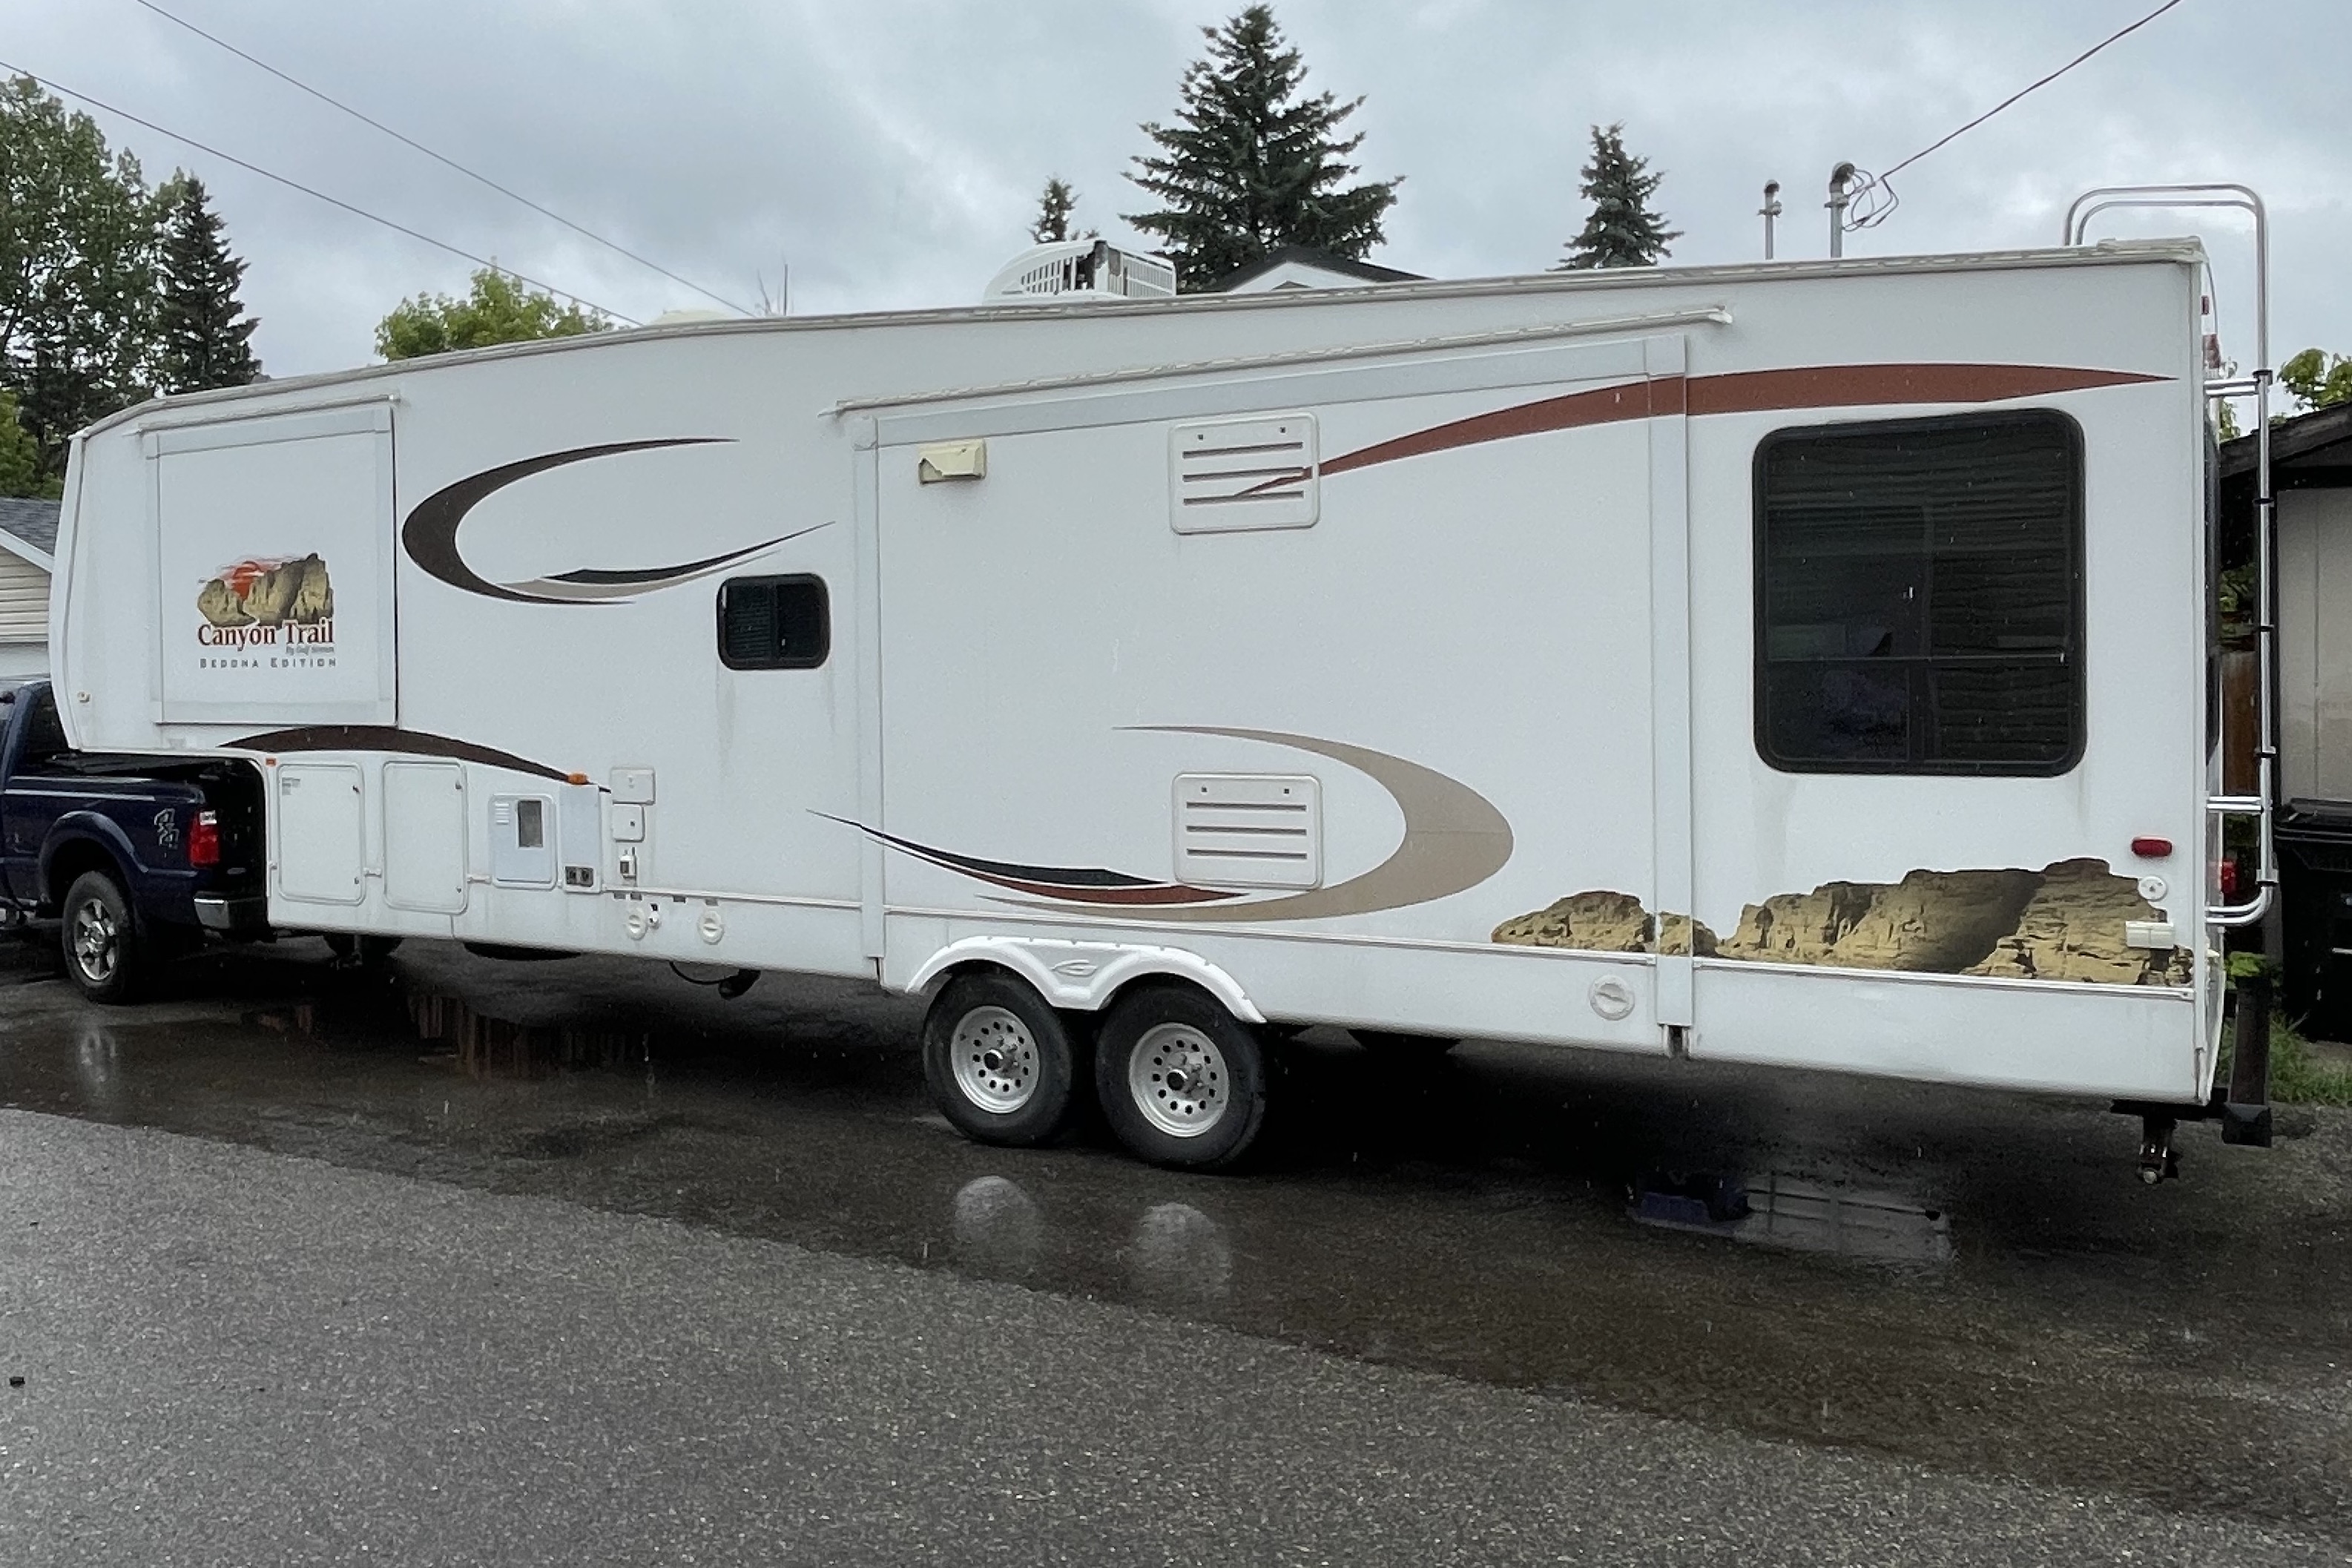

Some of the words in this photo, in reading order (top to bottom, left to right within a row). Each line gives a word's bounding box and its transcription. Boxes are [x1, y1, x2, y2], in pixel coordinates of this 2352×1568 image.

[198, 624, 277, 651] Canyon
[283, 619, 335, 645] Trail
[271, 657, 336, 668] EDITION
